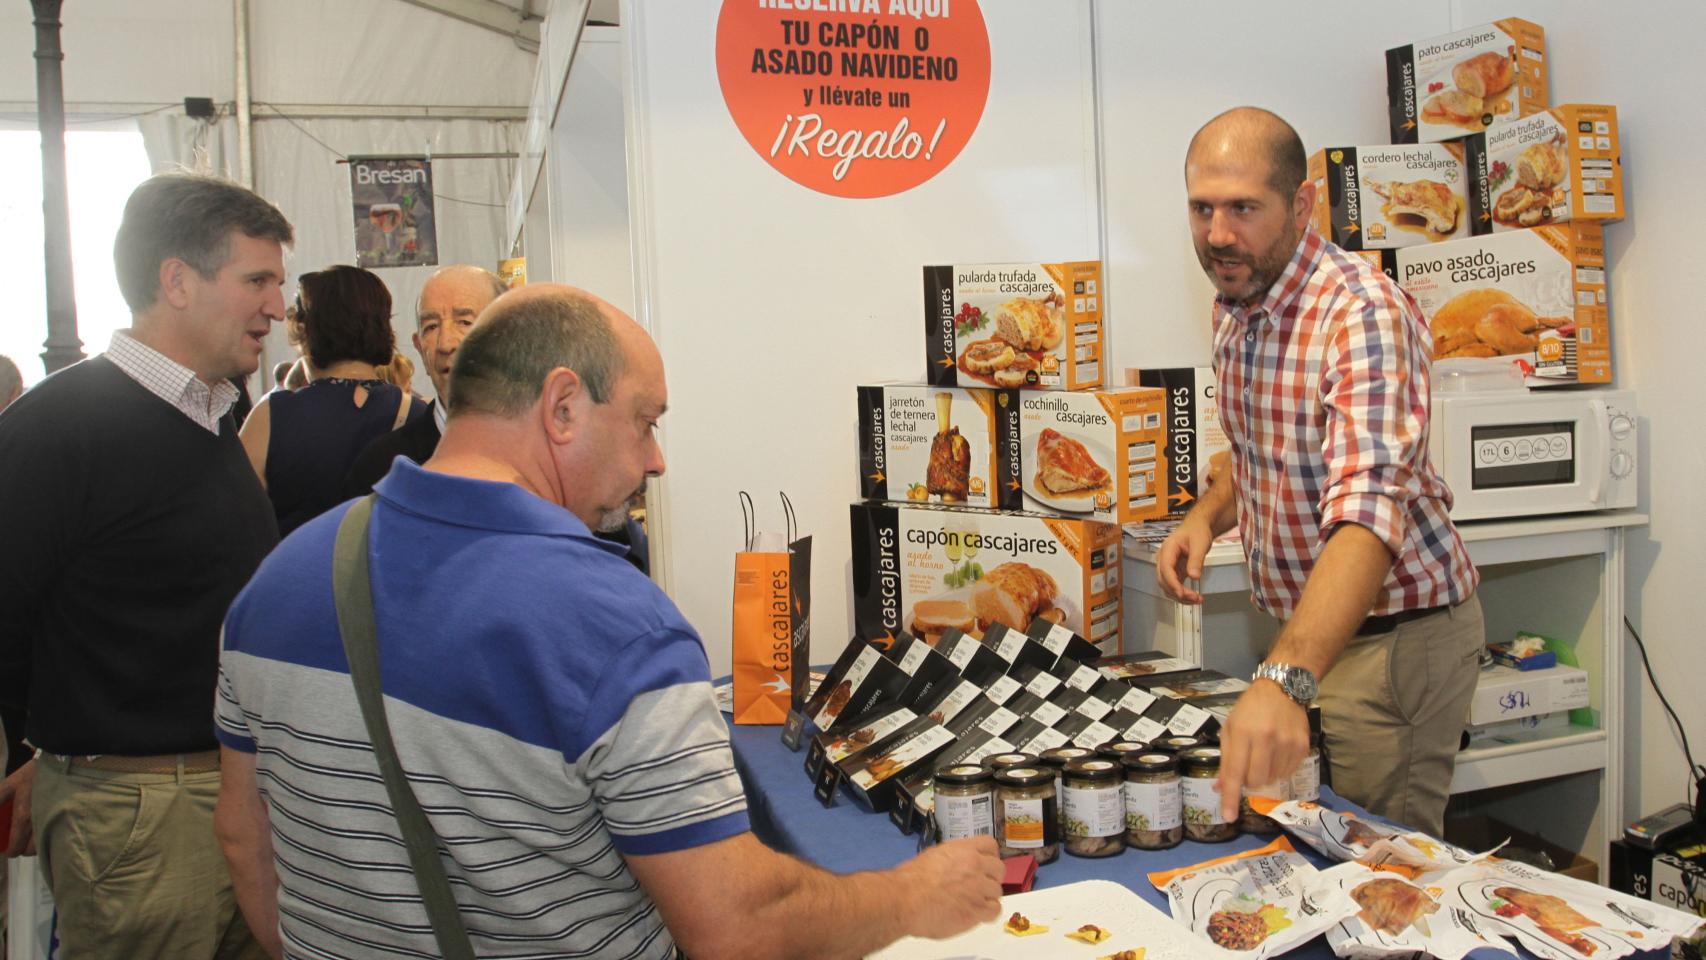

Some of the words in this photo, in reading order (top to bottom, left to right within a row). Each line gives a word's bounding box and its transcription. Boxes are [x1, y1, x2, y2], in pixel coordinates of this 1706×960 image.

[781, 20, 810, 45] TU
[818, 19, 899, 50] CAPÓN
[915, 27, 929, 51] O
[1418, 46, 1441, 60] pato
[1443, 32, 1496, 52] cascajares
[751, 48, 833, 75] ASADO
[803, 87, 813, 107] y
[820, 85, 882, 108] llévate
[888, 91, 911, 108] un
[1402, 62, 1416, 118] cascajares
[1489, 128, 1517, 146] pularda
[1517, 119, 1545, 135] trufada
[1518, 123, 1559, 144] cascajares
[771, 113, 946, 181] ¡Regalo!
[1362, 152, 1401, 164] cordero
[1403, 150, 1433, 161] lechal
[356, 164, 427, 185] Bresan
[1406, 158, 1457, 171] cascajares
[1345, 164, 1359, 221] cascajares
[1478, 151, 1490, 209] cascajares
[958, 270, 996, 285] pularda
[999, 270, 1036, 283] trufada
[1405, 258, 1443, 280] pavo
[1447, 249, 1495, 271] asado
[1451, 260, 1536, 283] cascajares
[999, 280, 1055, 295] cascajares
[941, 288, 954, 354] cascajares
[889, 396, 925, 409] jarretón
[890, 409, 901, 420] de
[903, 410, 936, 420] ternera
[1023, 397, 1069, 412] cochinillo
[890, 421, 916, 432] lechal
[1056, 411, 1107, 428] cascajares
[873, 407, 885, 469] cascajares
[891, 434, 928, 444] cascajares
[1008, 411, 1021, 477] cascajares
[1171, 386, 1195, 484] cascajares
[906, 527, 959, 550] capón
[964, 531, 1057, 557] cascajares
[877, 527, 900, 629] cascajares
[768, 569, 790, 673] cascajares
